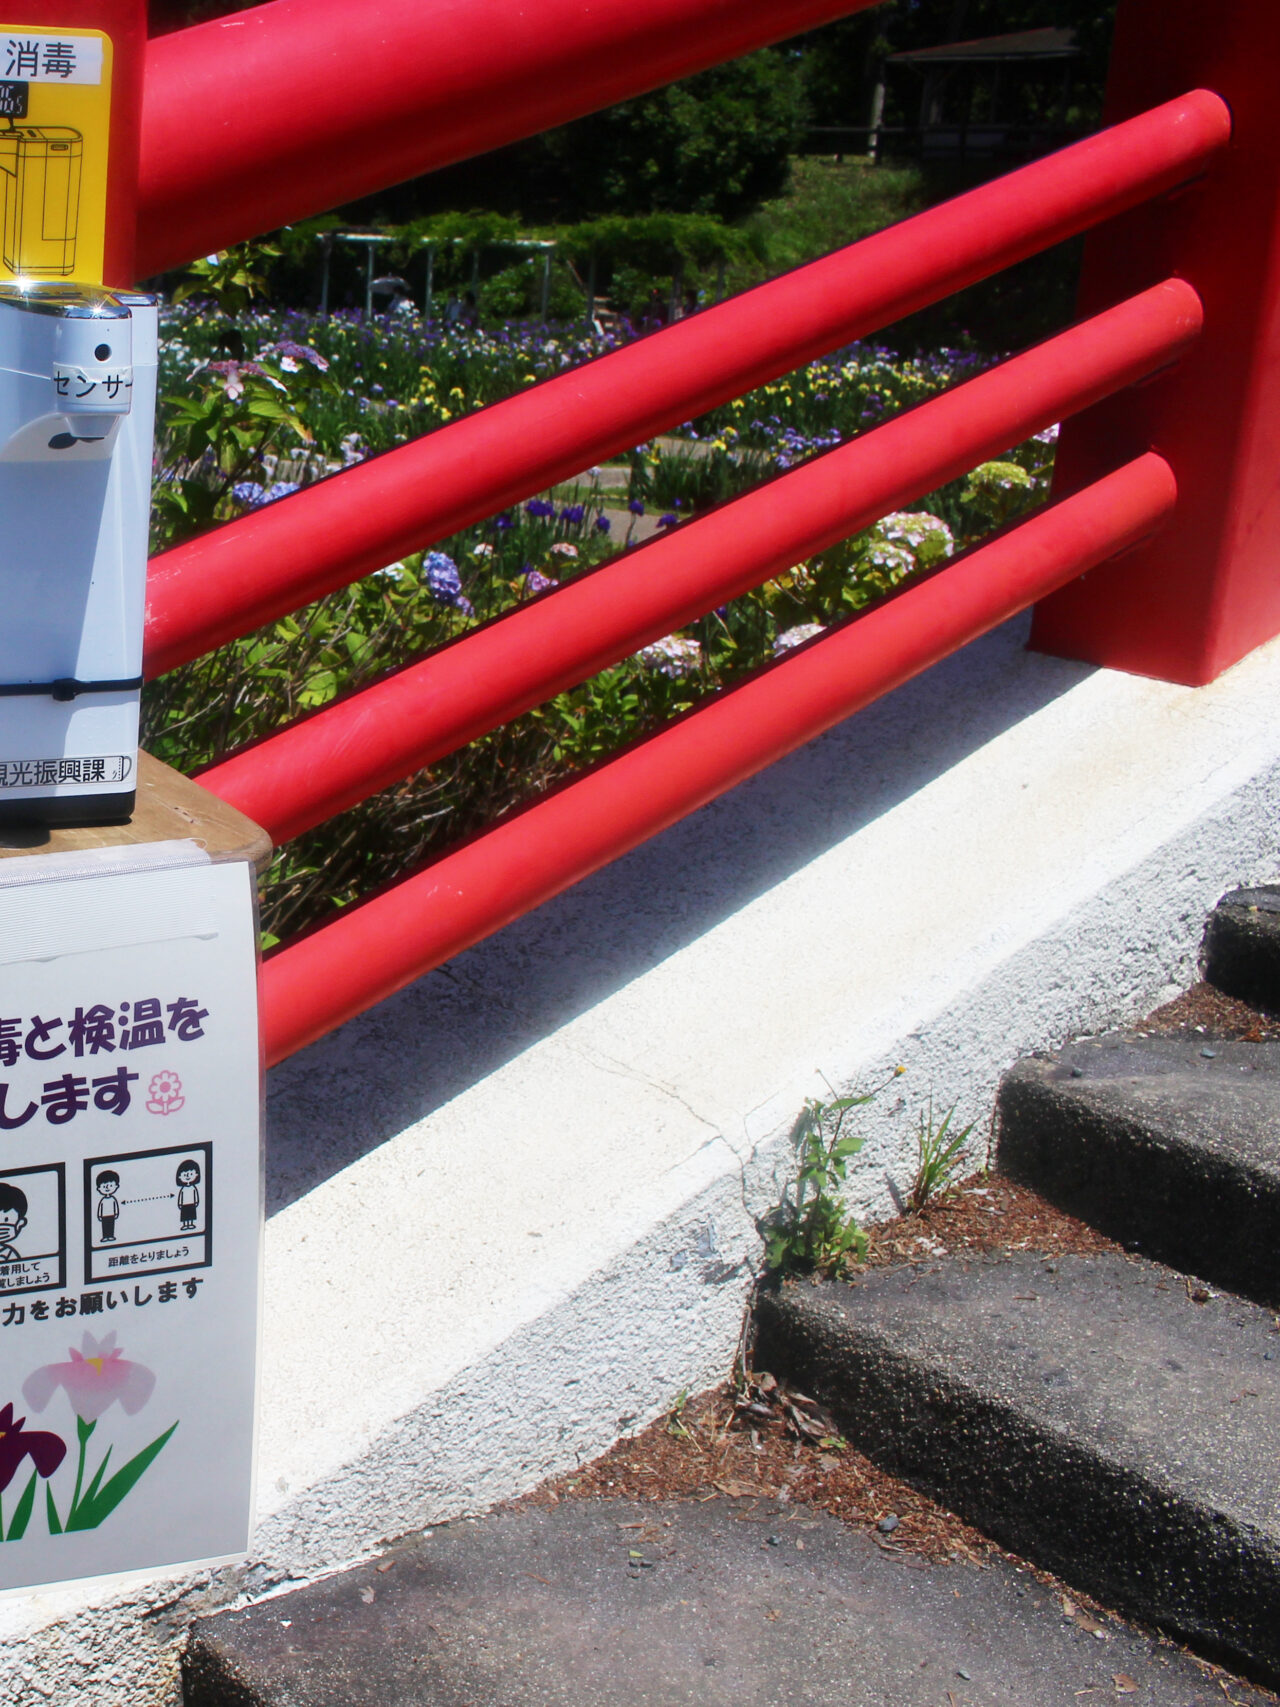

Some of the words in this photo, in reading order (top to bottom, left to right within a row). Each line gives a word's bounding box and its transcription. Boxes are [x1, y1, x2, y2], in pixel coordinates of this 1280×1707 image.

[108, 1246, 189, 1267] 距離をとりましょう
